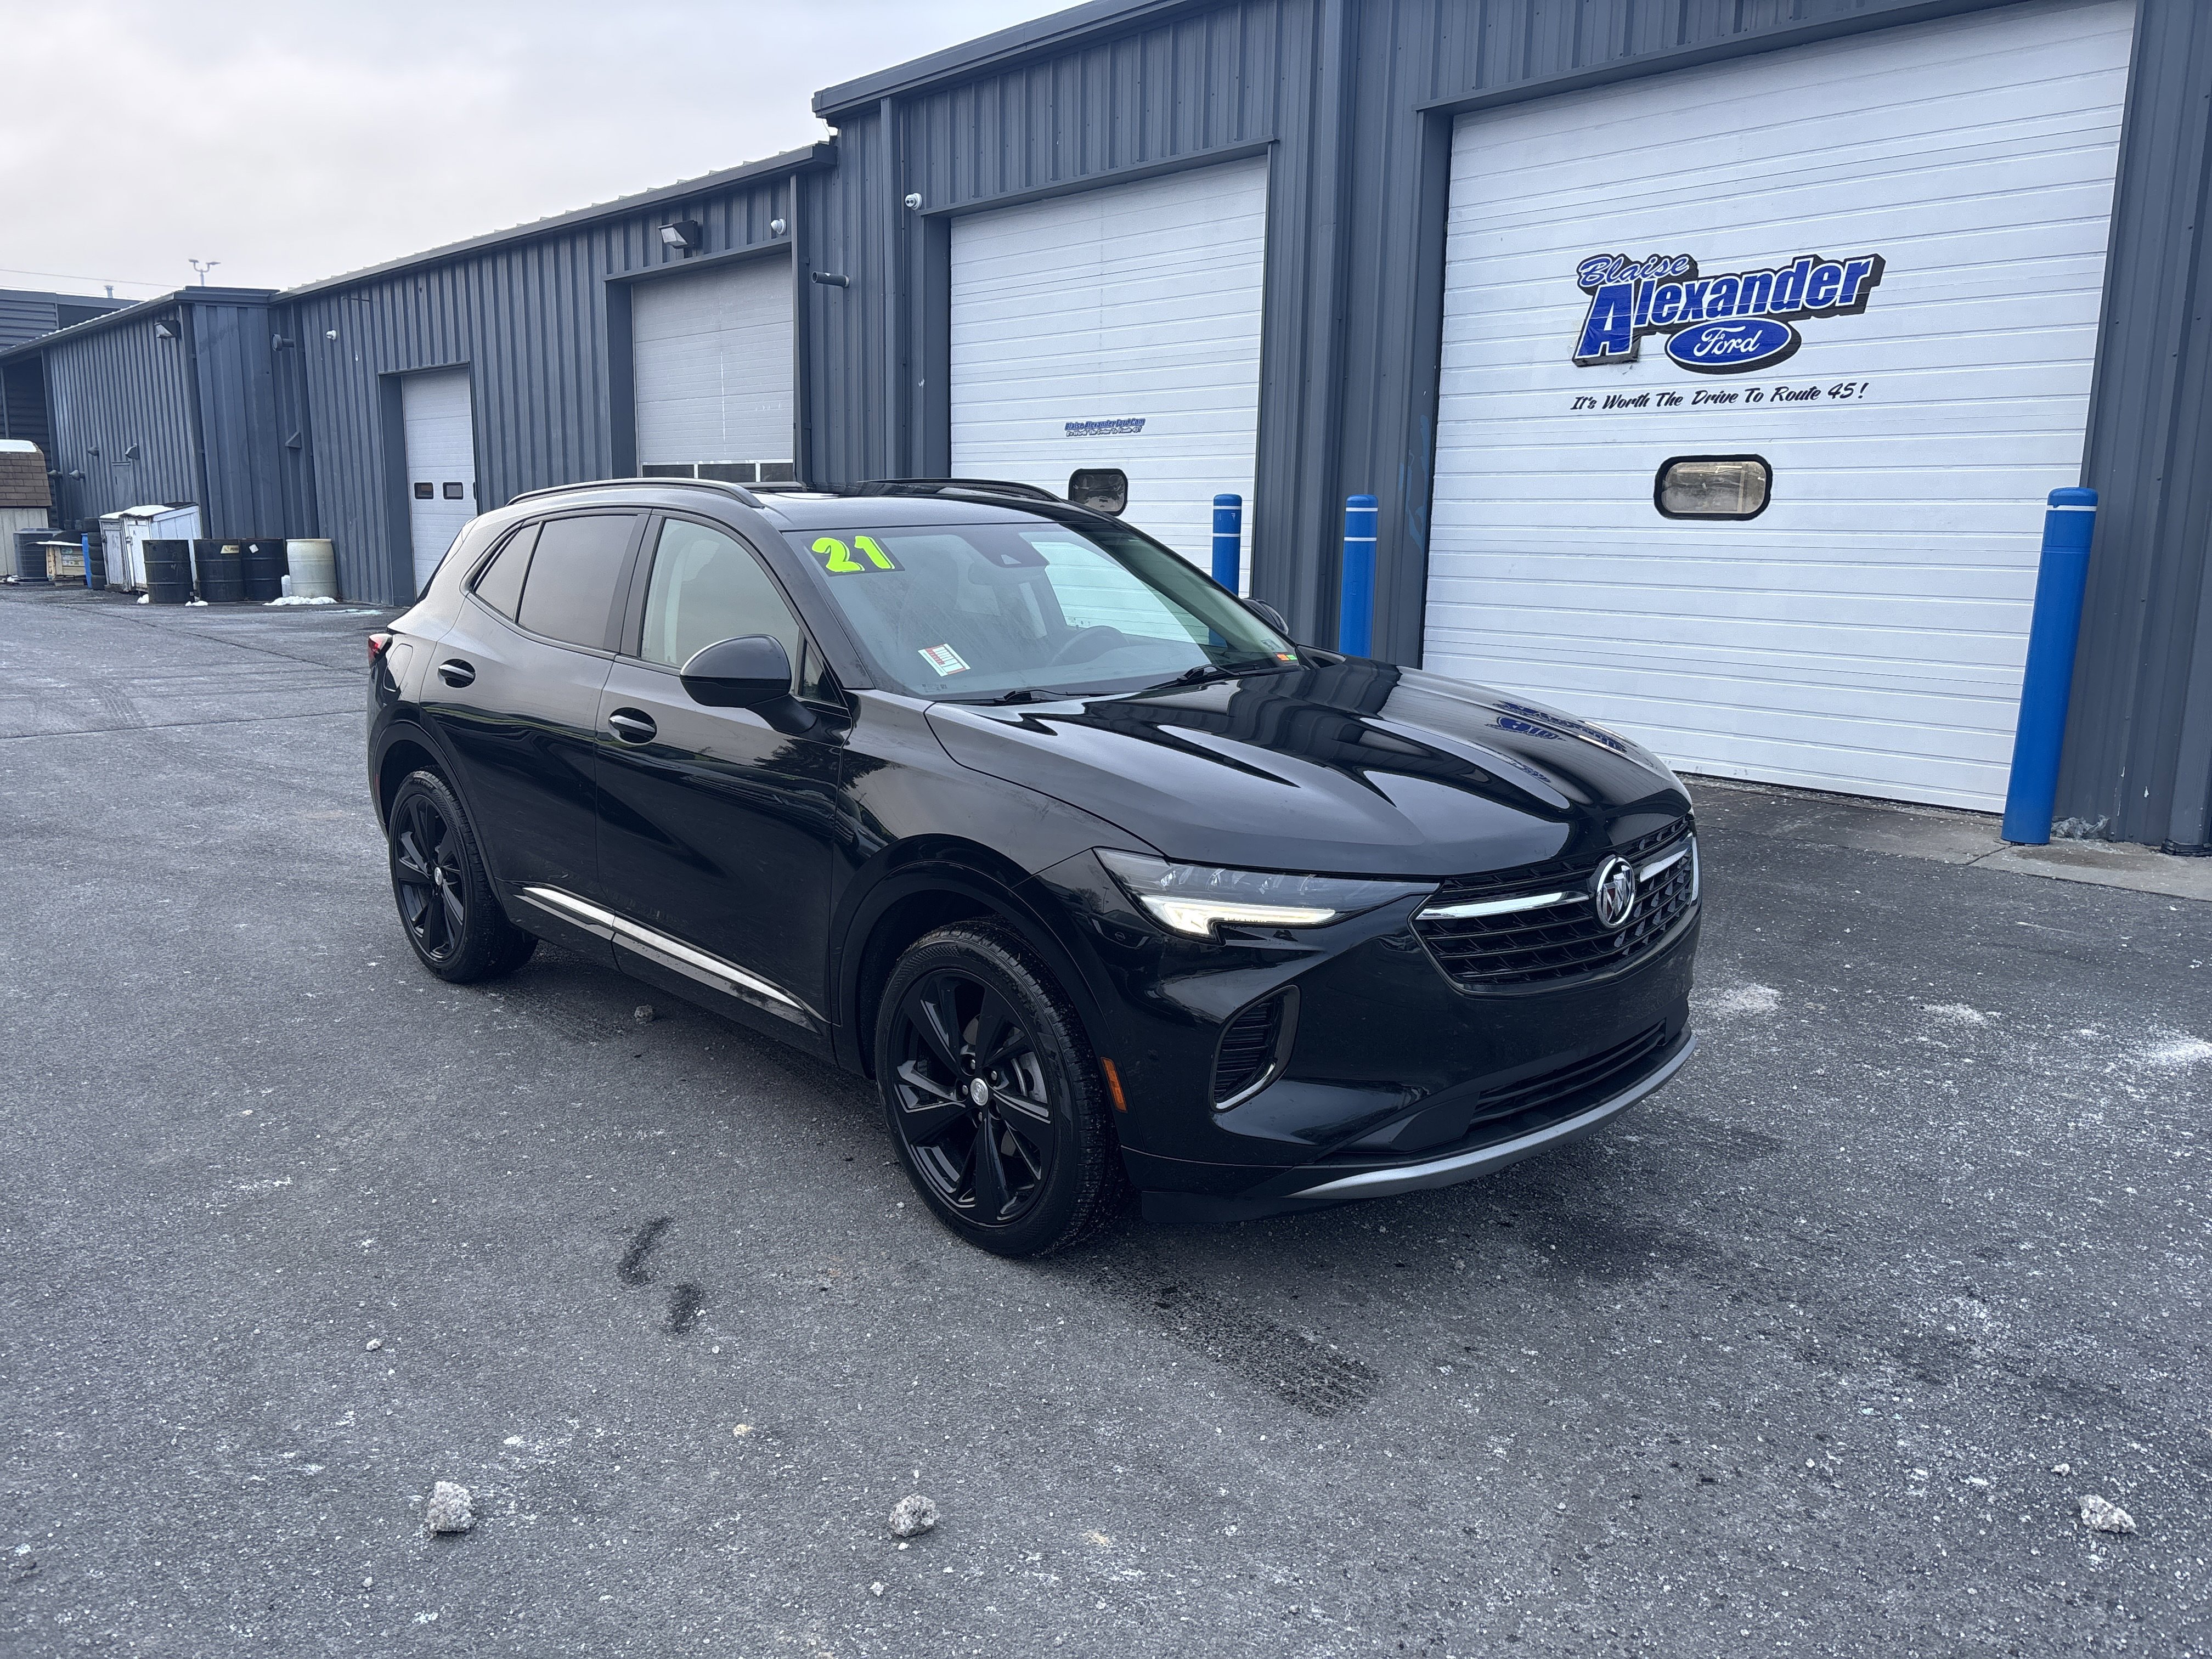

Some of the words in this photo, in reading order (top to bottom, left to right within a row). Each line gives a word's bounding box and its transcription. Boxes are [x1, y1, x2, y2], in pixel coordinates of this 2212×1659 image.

[1578, 256, 1690, 287] Blaise
[1575, 256, 1874, 359] Alexander
[1693, 326, 1762, 357] Ford
[1570, 396, 1598, 410] It's
[1601, 392, 1650, 410] Worth
[1656, 391, 1684, 408] The
[1691, 390, 1739, 405] Drive
[1745, 387, 1764, 403] To
[1770, 386, 1821, 402] Route
[811, 535, 895, 573] 21
